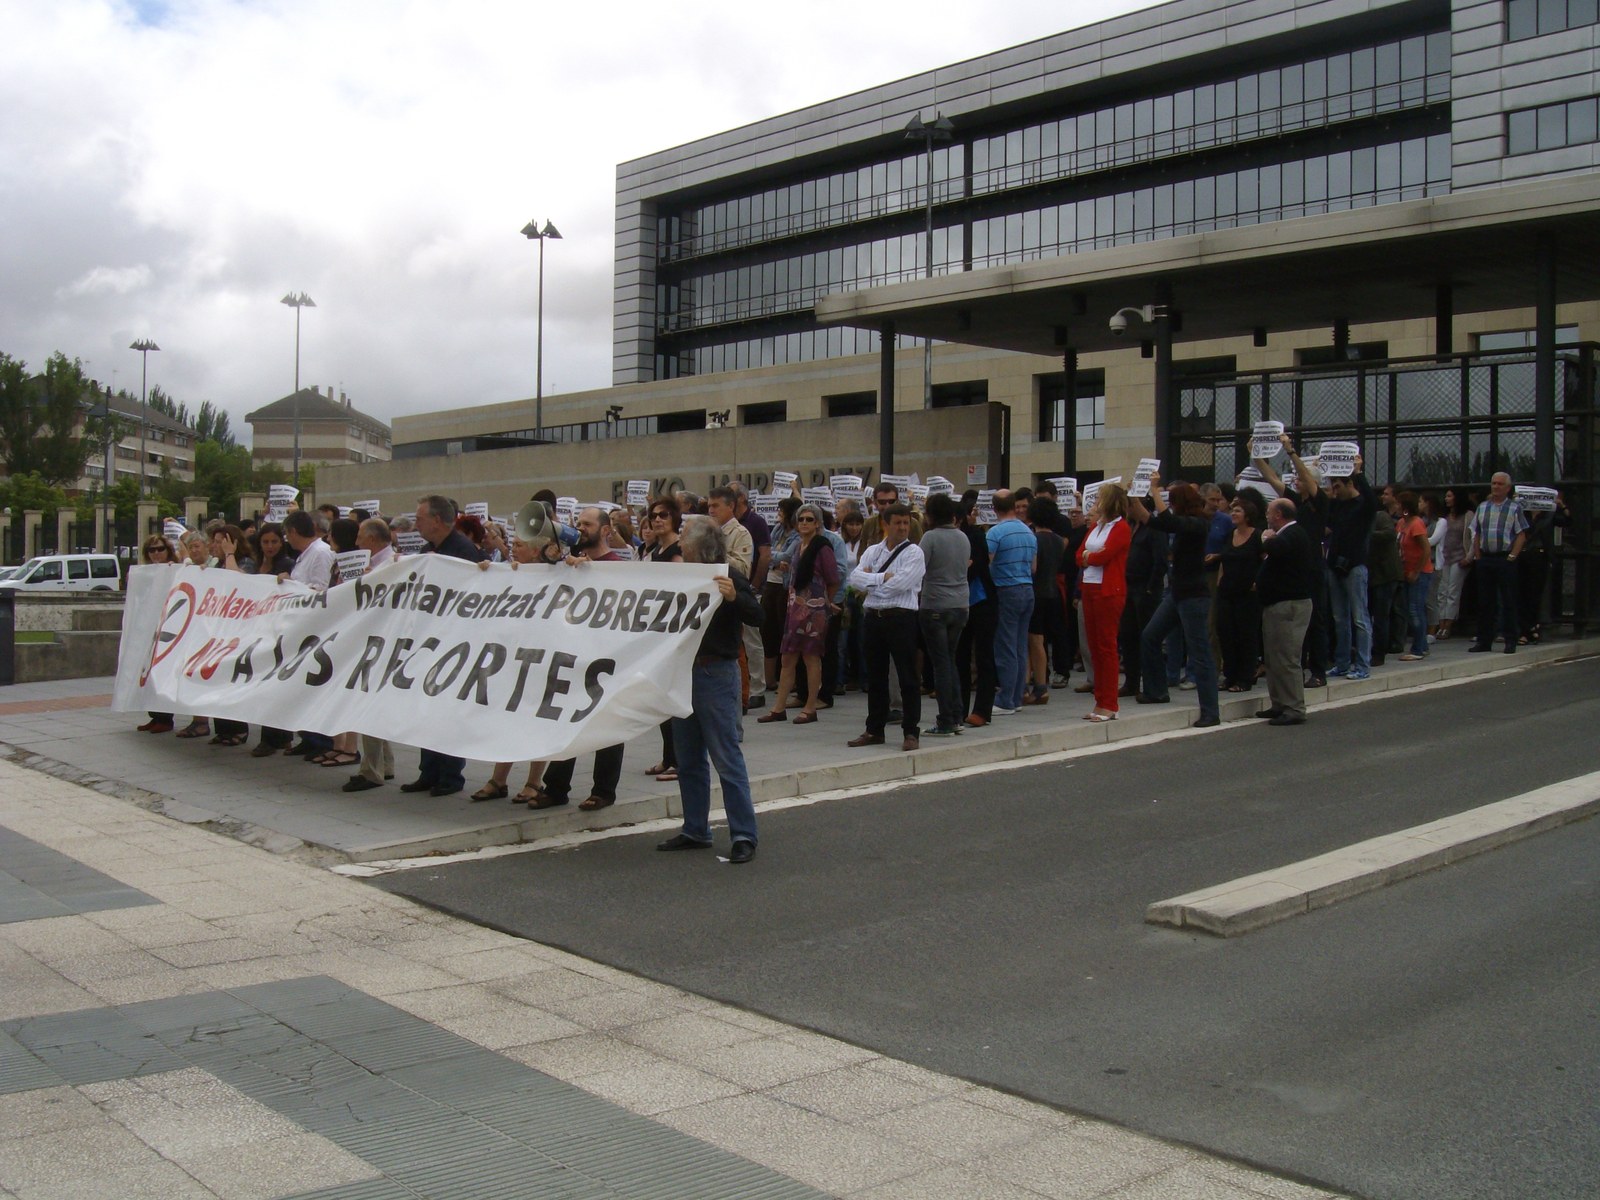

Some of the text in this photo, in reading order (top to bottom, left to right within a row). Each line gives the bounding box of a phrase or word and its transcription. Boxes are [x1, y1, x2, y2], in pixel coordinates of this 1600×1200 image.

[1319, 454, 1355, 462] POBREZIA
[355, 571, 549, 620] herritarrentzat
[542, 583, 711, 634] POBREZIA
[184, 636, 239, 681] NO
[230, 637, 262, 684] A
[345, 635, 616, 723] RECORTES
